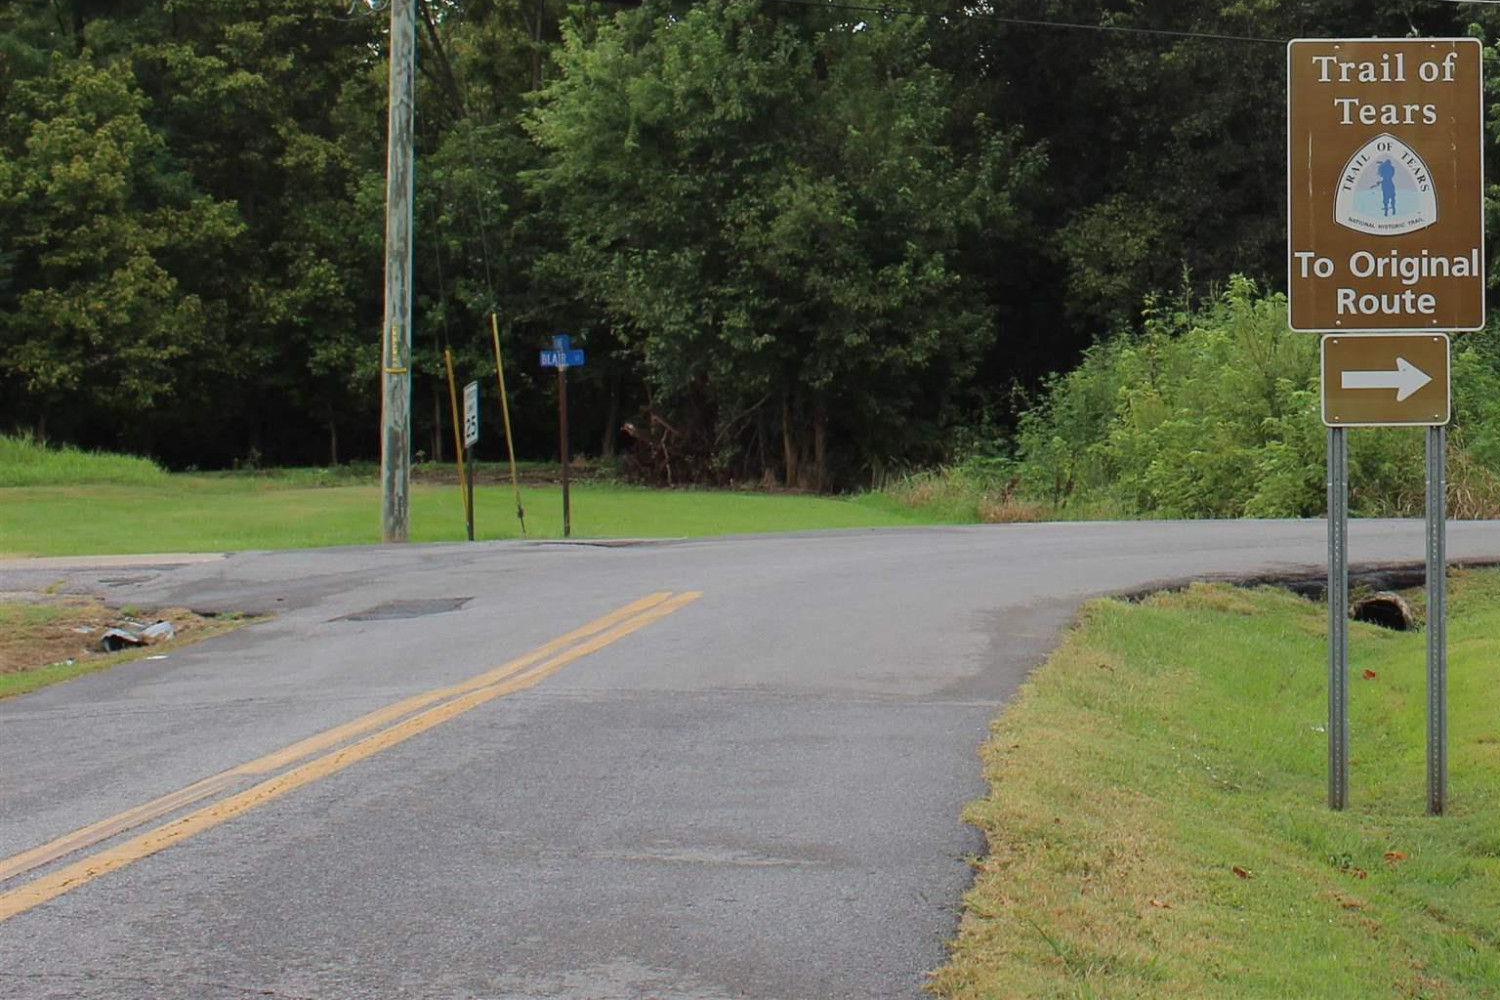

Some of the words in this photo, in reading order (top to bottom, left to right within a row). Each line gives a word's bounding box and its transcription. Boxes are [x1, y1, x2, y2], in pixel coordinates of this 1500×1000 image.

[1312, 53, 1406, 82] Trail
[1418, 52, 1458, 82] of
[1334, 98, 1437, 125] Tears
[1342, 154, 1371, 192] TRAIL
[1377, 142, 1394, 152] OF
[1400, 150, 1430, 193] TEARS
[1348, 216, 1376, 229] NATIONAL
[1378, 222, 1405, 230] HISTORIC
[1294, 251, 1335, 278] To
[1349, 248, 1479, 285] Original
[1336, 288, 1436, 315] Route
[541, 353, 567, 366] BLAIR
[465, 415, 477, 438] 25
